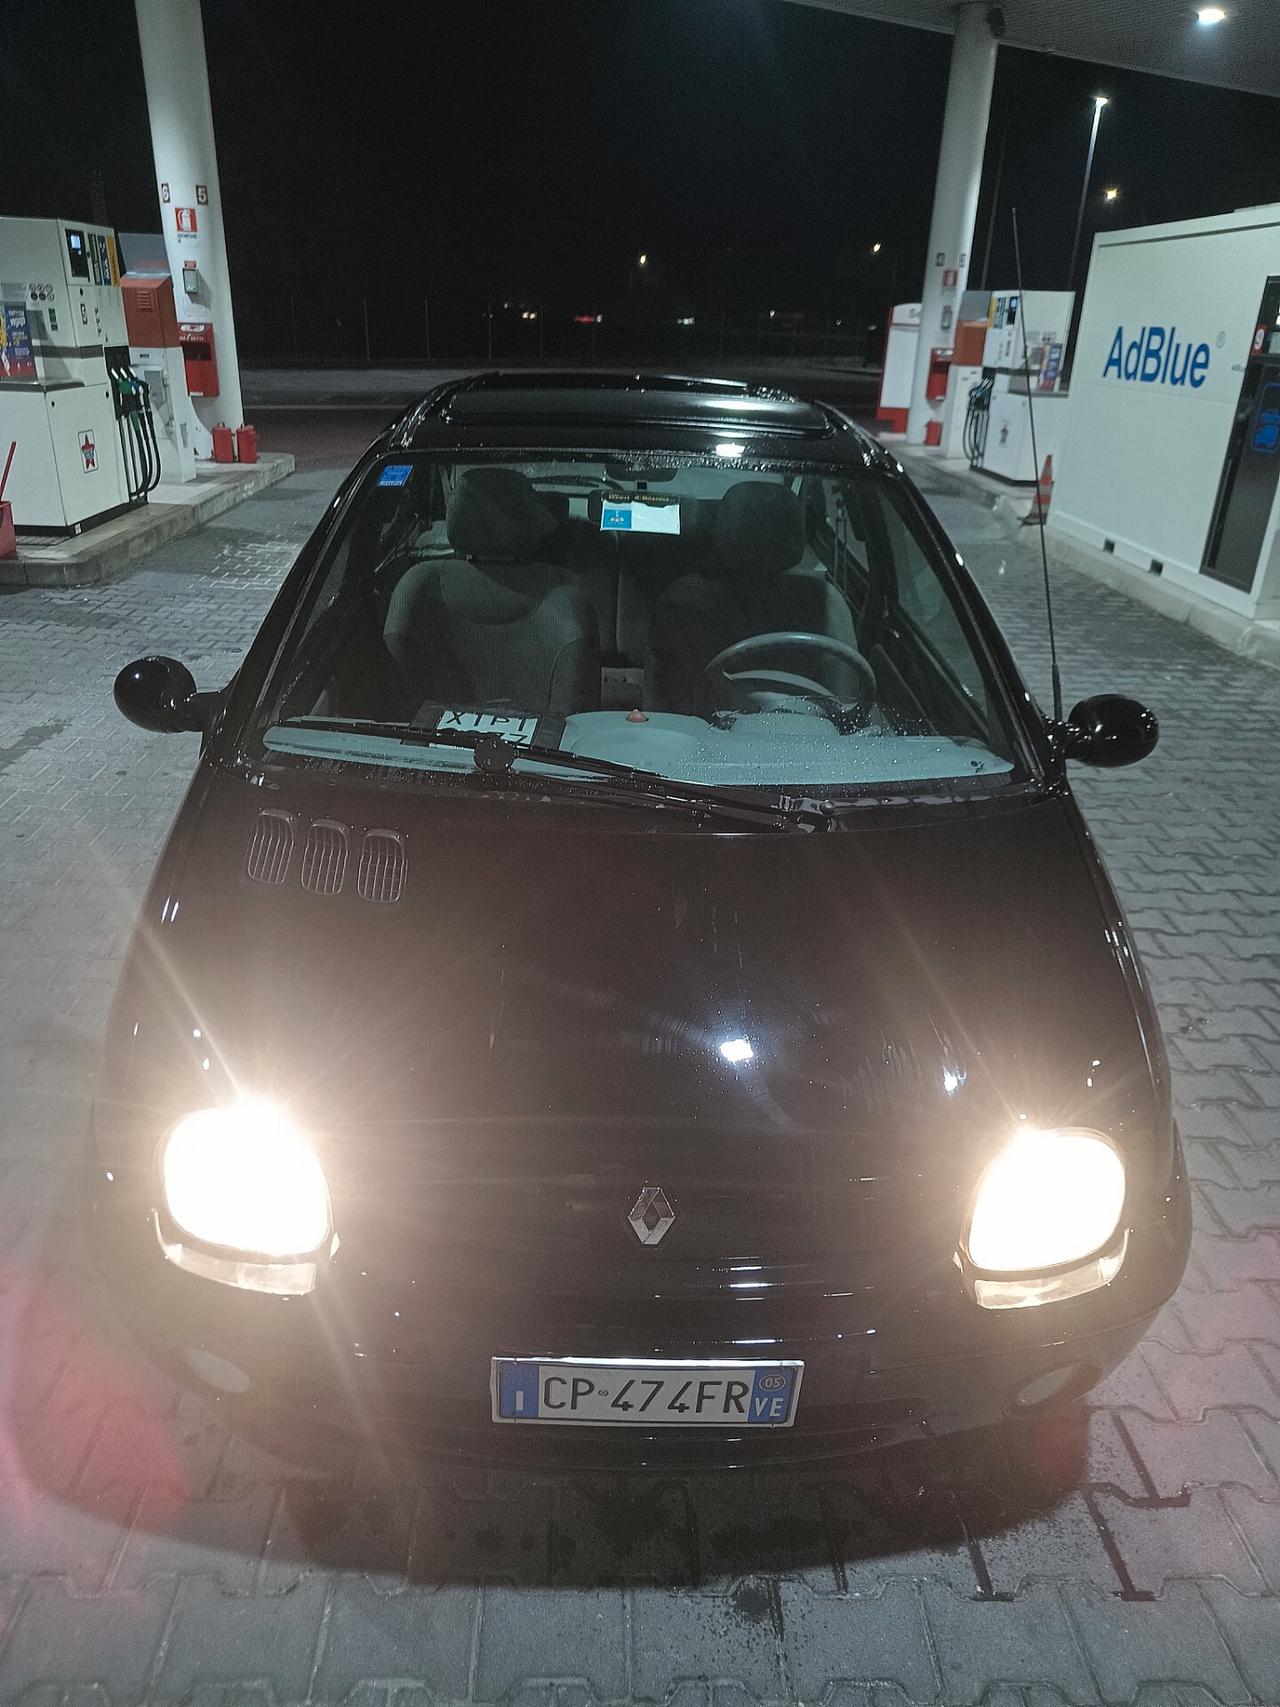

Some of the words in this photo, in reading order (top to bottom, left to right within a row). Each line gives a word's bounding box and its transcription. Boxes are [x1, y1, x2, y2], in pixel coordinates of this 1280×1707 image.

[198, 187, 207, 203] 5
[1103, 326, 1211, 388] AdBlue
[543, 1376, 595, 1410] CP
[611, 1378, 750, 1414] 474FR
[755, 1397, 784, 1417] VE
